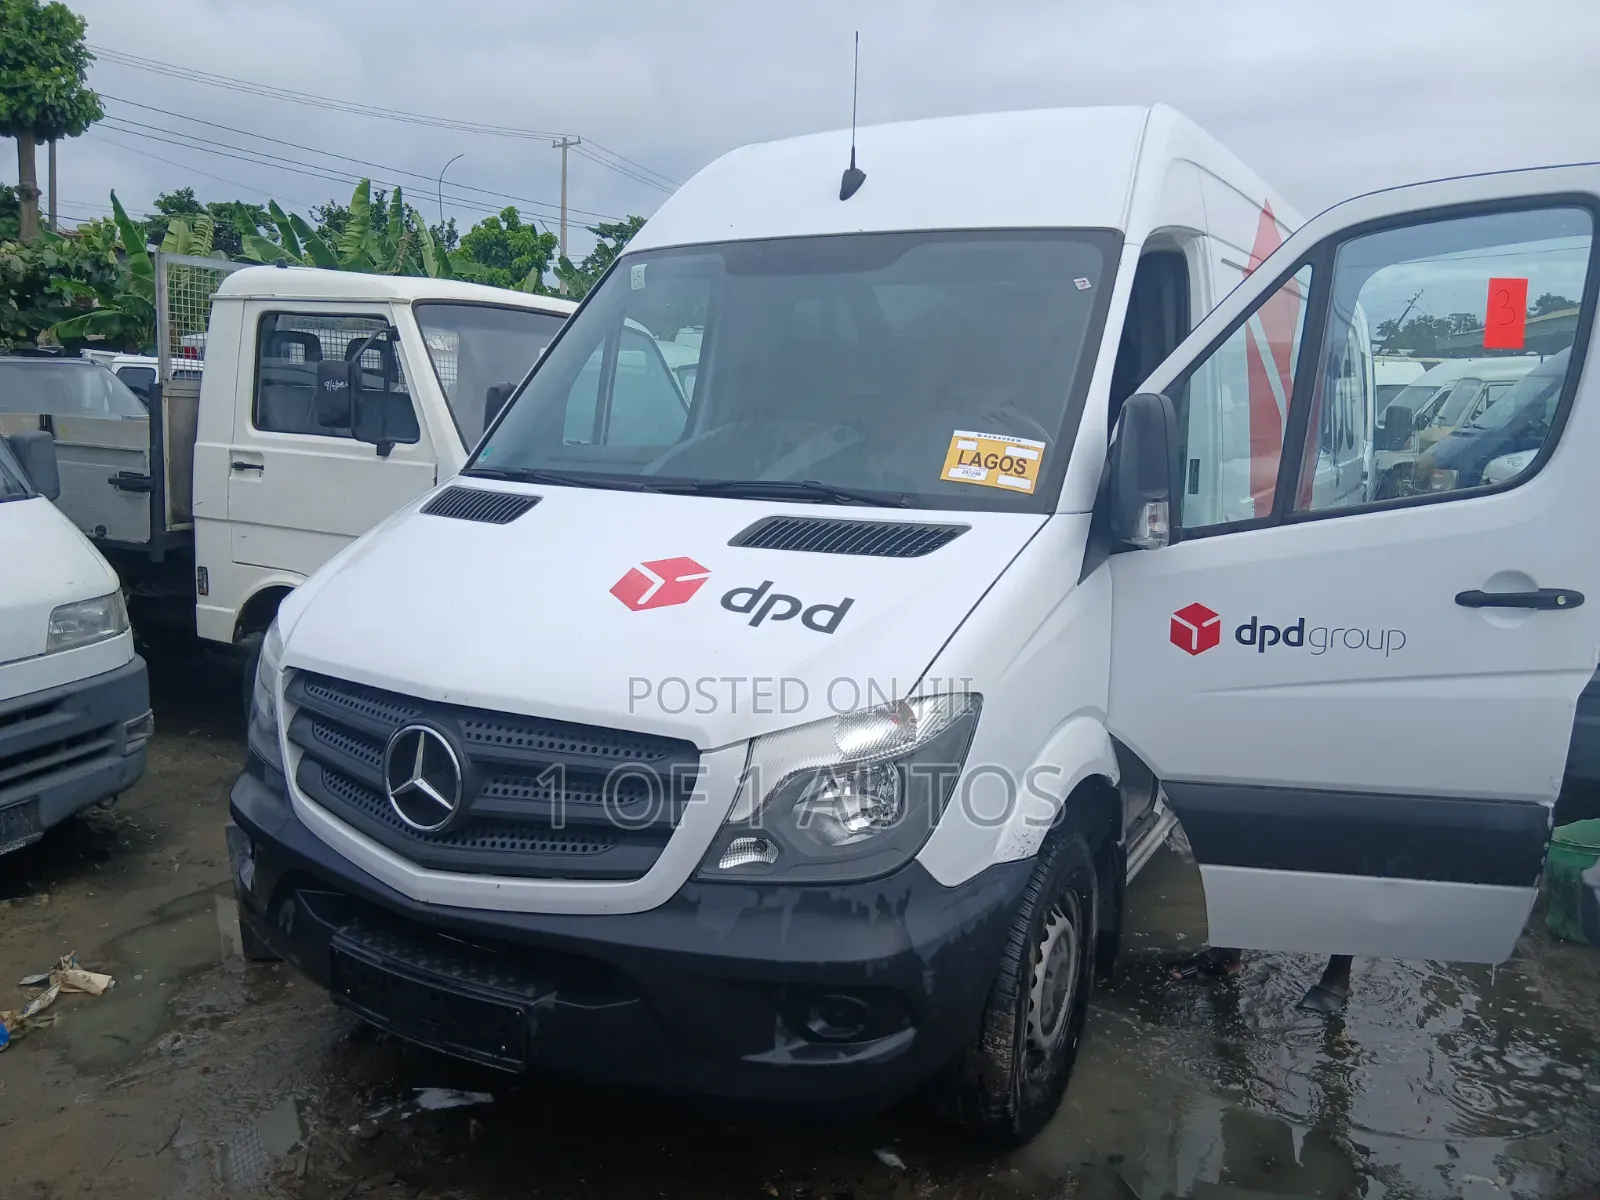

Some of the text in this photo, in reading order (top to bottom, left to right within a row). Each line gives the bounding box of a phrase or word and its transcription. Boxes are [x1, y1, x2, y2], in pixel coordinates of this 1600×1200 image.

[1495, 289, 1516, 326] 3
[957, 450, 1028, 475] LAGOS
[720, 580, 855, 635] dpd
[1234, 615, 1406, 657] dpdgroup
